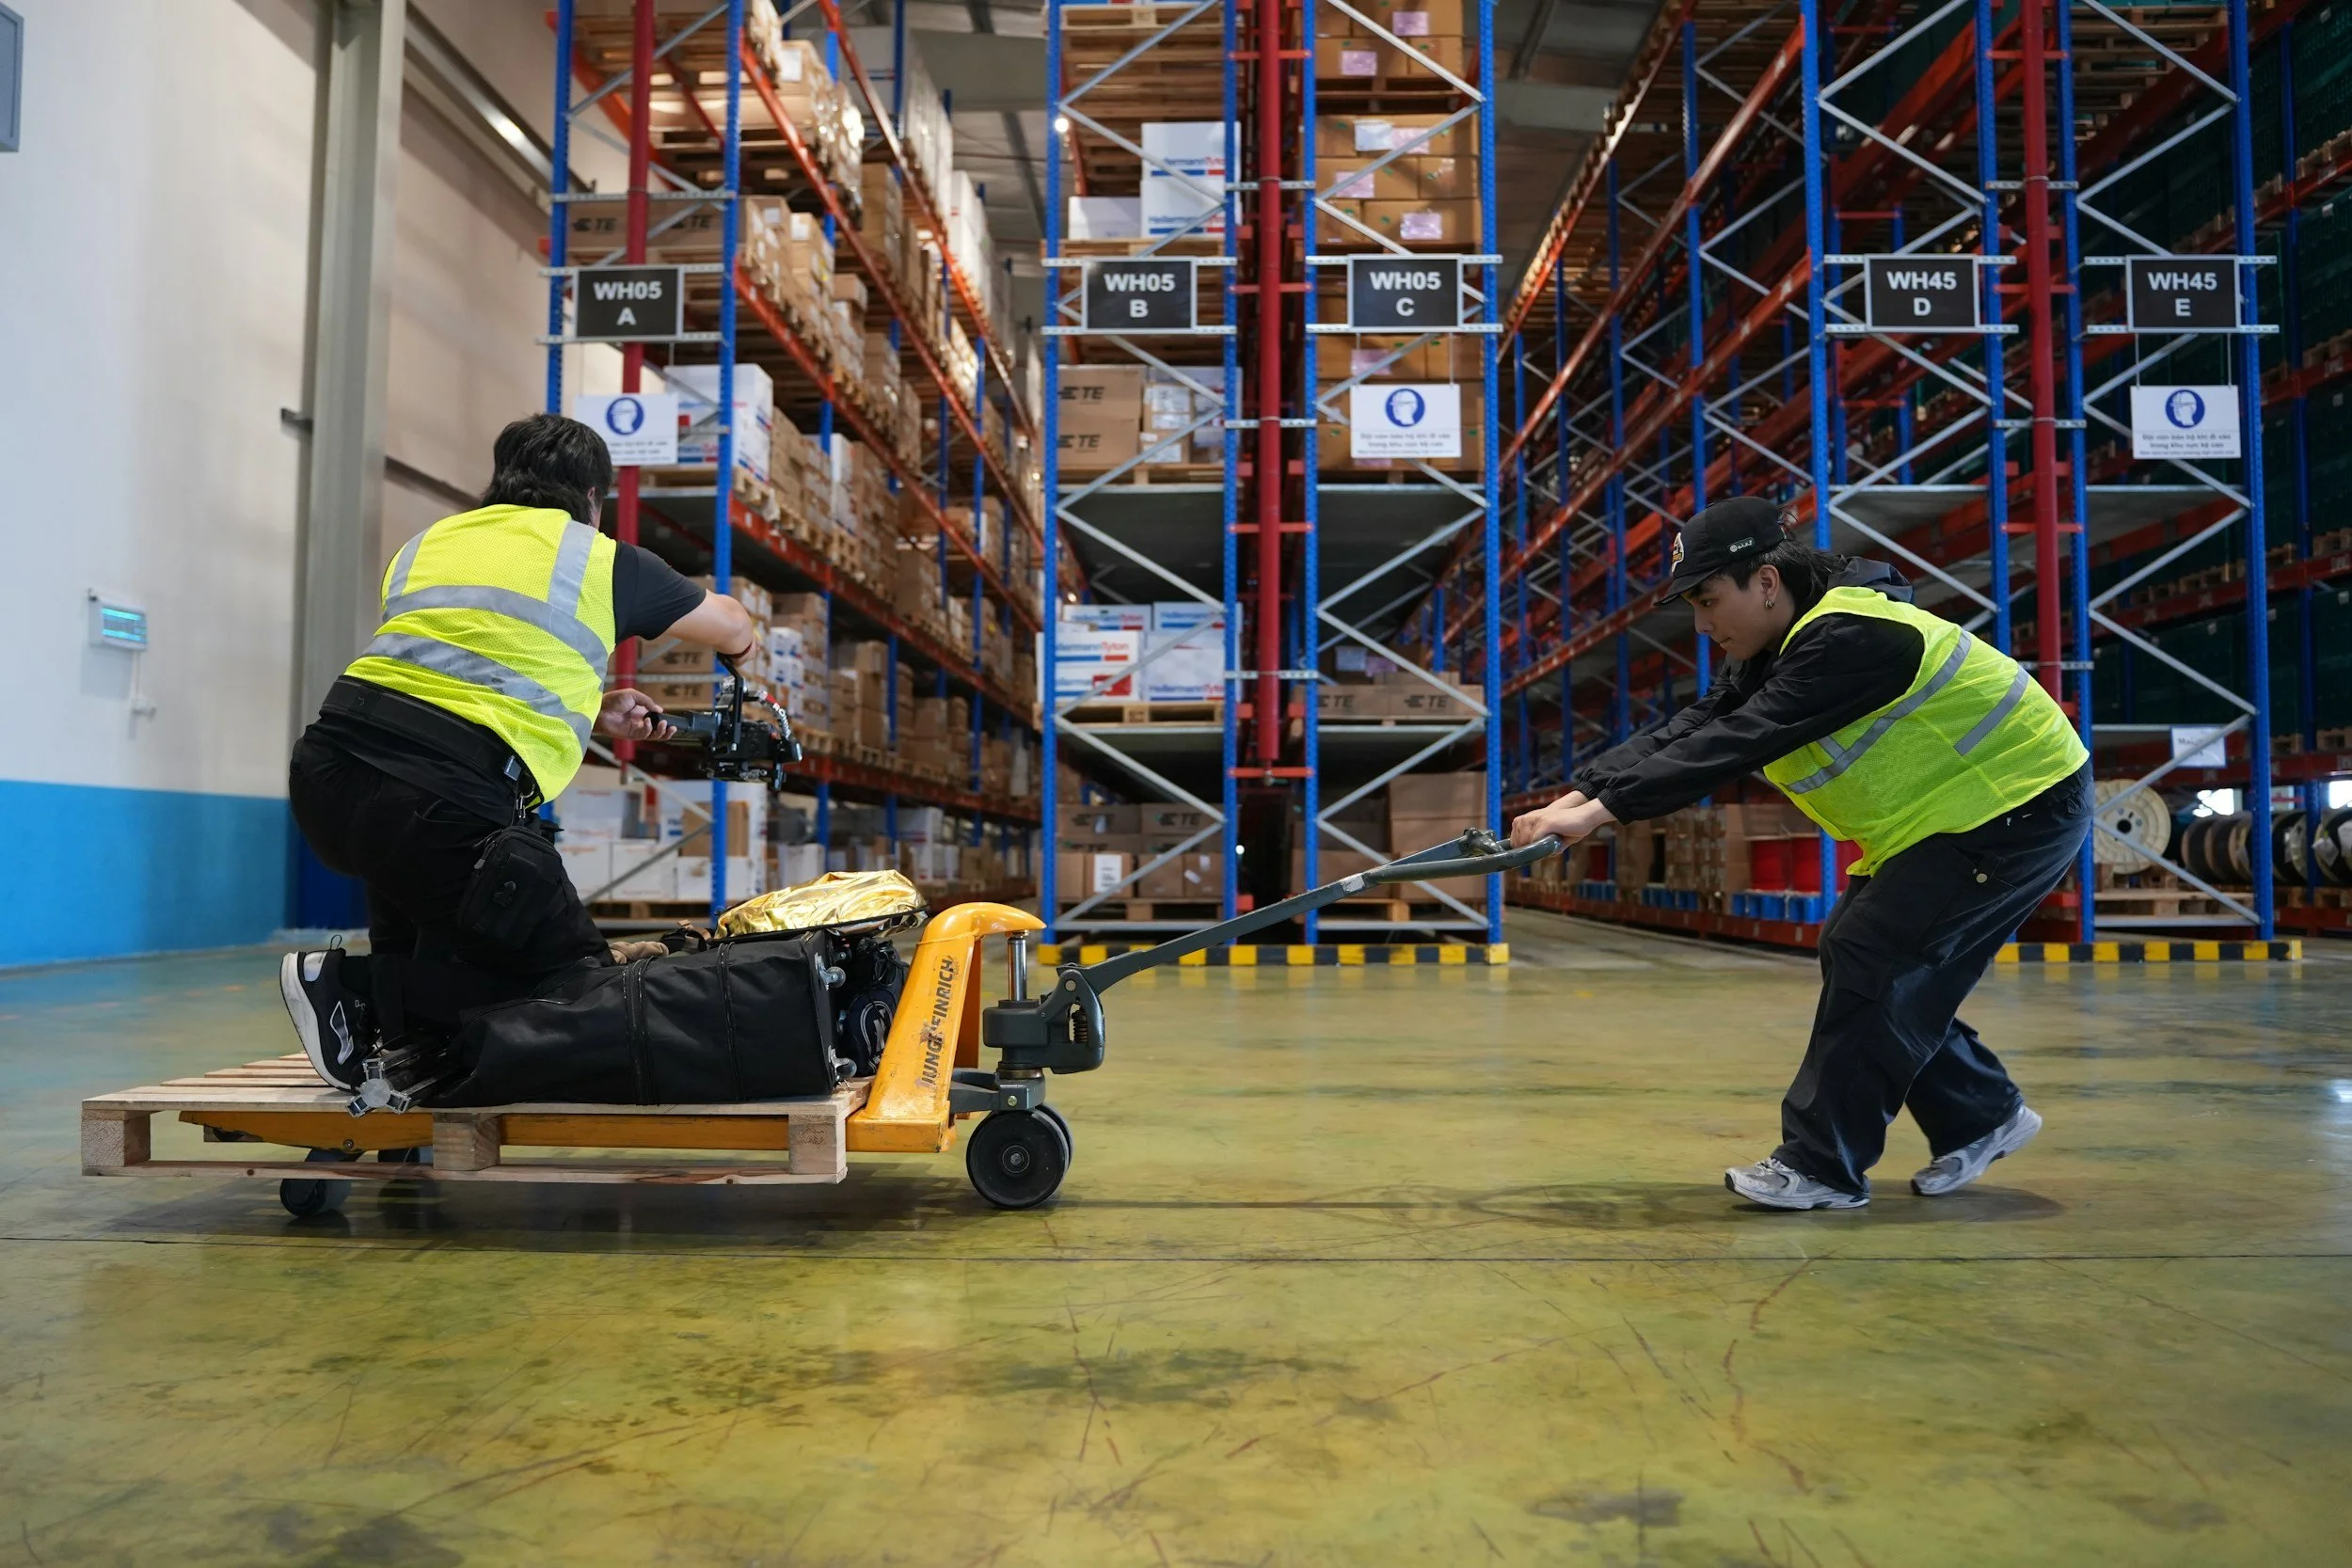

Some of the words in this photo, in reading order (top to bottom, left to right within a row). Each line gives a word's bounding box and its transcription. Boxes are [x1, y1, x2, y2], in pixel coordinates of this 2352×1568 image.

[593, 280, 662, 300] WH05
[1103, 273, 1176, 293] WH05
[1369, 271, 1441, 291] WH05
[1886, 271, 1957, 291] WH45
[2147, 272, 2217, 291] WH45
[616, 307, 637, 325] A
[1129, 299, 1149, 318] B
[1395, 297, 1414, 317] C
[1914, 297, 1931, 316] D
[2175, 298, 2191, 317] E
